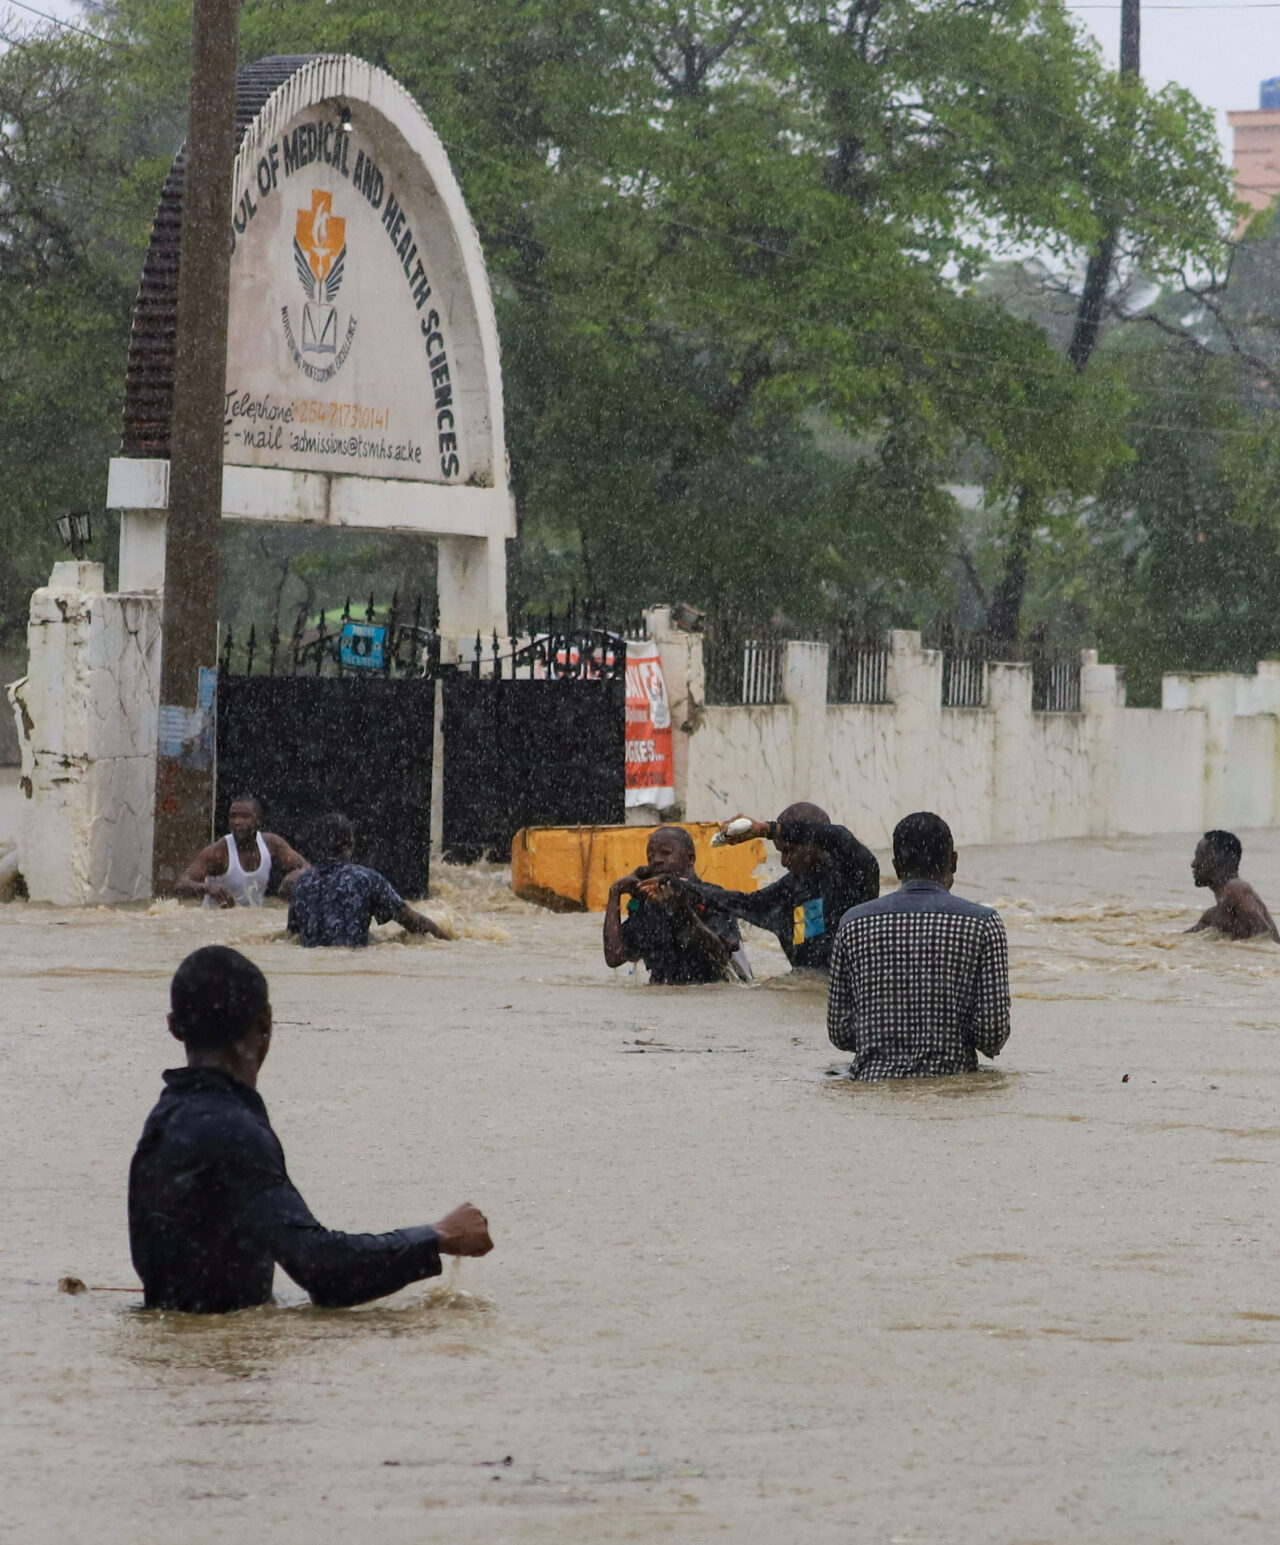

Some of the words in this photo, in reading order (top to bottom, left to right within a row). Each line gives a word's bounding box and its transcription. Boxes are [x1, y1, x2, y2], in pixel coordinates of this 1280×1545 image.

[257, 143, 279, 197] OF
[283, 121, 350, 178] MEDICAL
[353, 149, 385, 209] AND
[381, 192, 432, 311] HEALTH
[420, 308, 459, 479] SCIENCES
